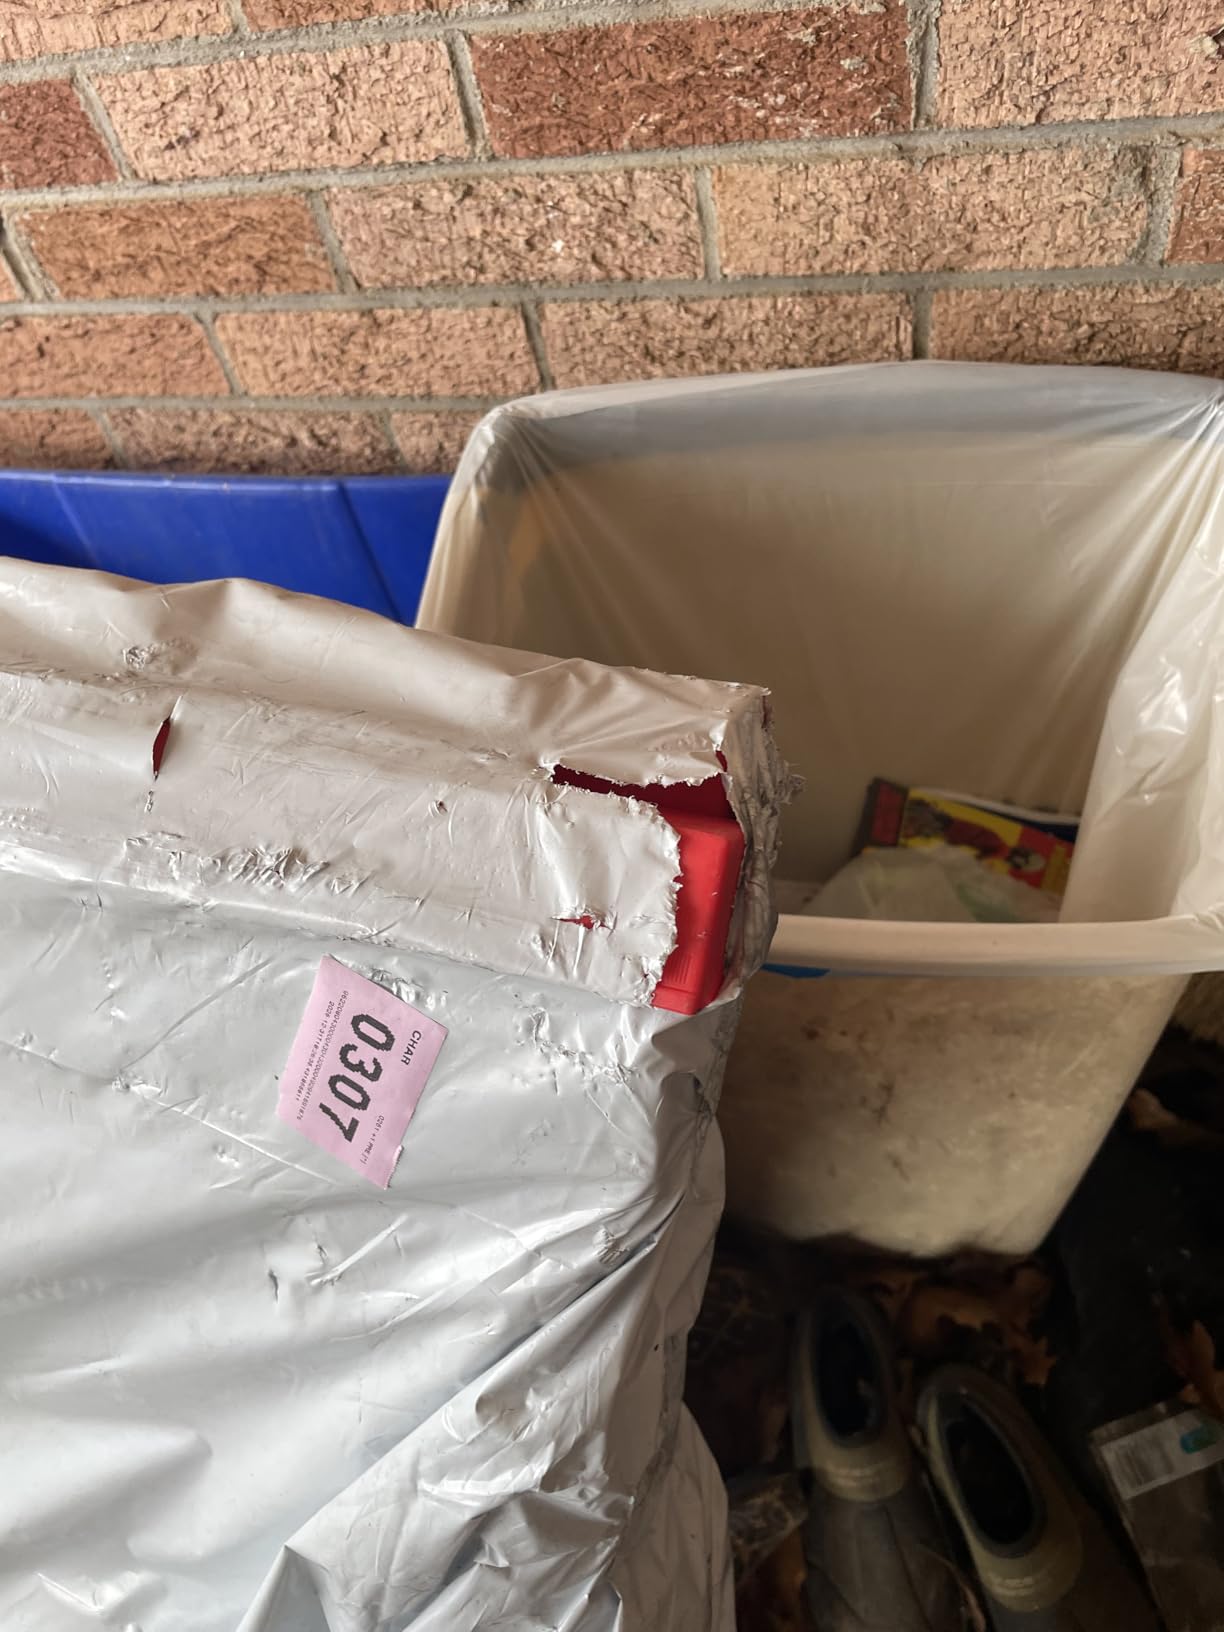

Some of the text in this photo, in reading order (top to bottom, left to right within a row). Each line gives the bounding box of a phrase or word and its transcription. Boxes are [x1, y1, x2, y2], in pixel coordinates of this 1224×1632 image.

[400, 1030, 422, 1066] CHAR
[319, 1013, 396, 1142] 0307
[364, 1142, 374, 1154] PRE
